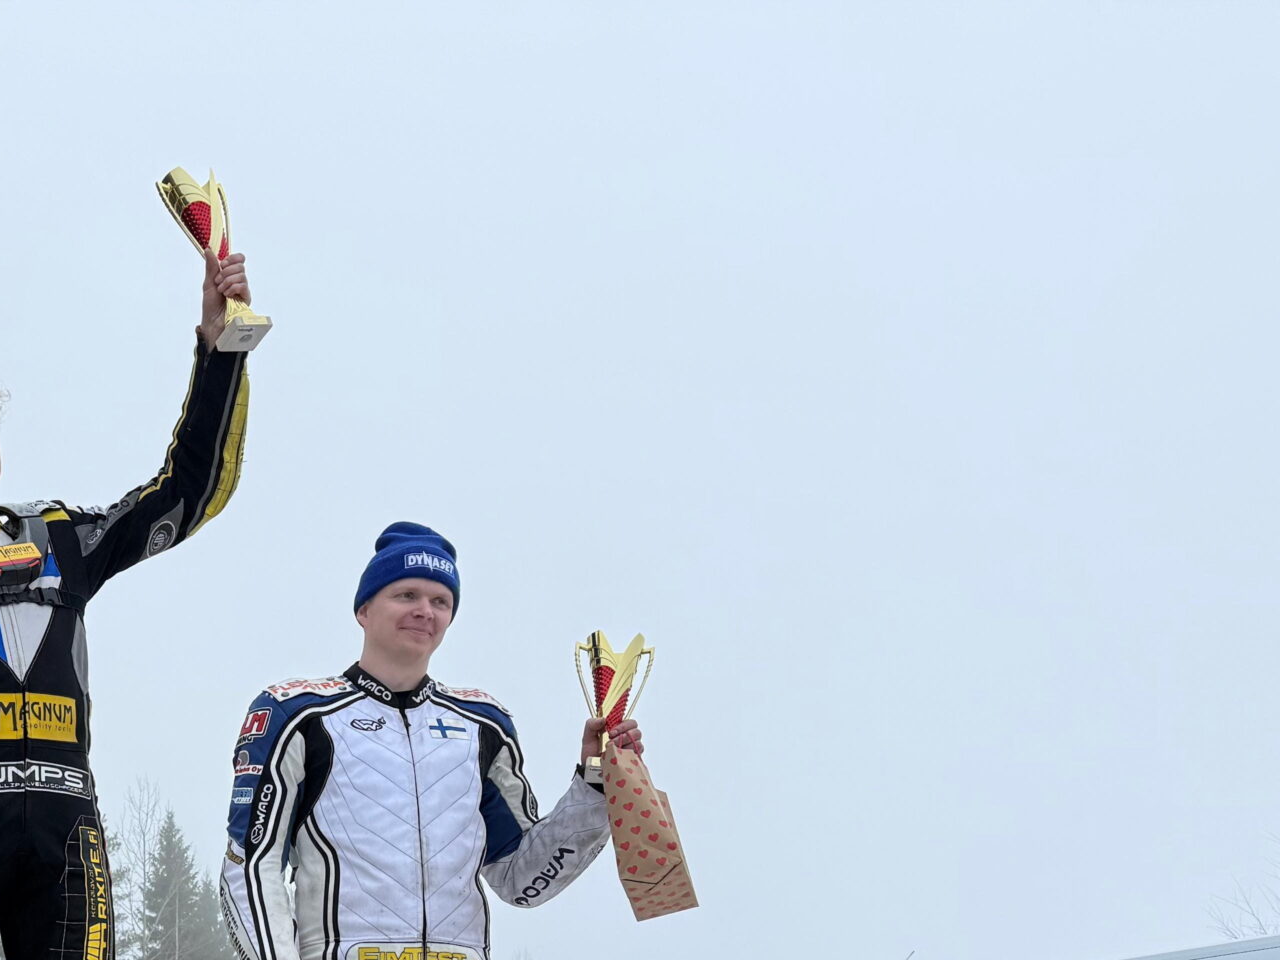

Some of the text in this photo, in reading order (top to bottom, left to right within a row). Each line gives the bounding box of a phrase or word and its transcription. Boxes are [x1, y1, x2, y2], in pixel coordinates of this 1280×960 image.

[407, 552, 454, 574] DYNASET
[357, 674, 392, 701] WACO
[256, 783, 274, 824] WACO
[521, 847, 575, 899] WACO
